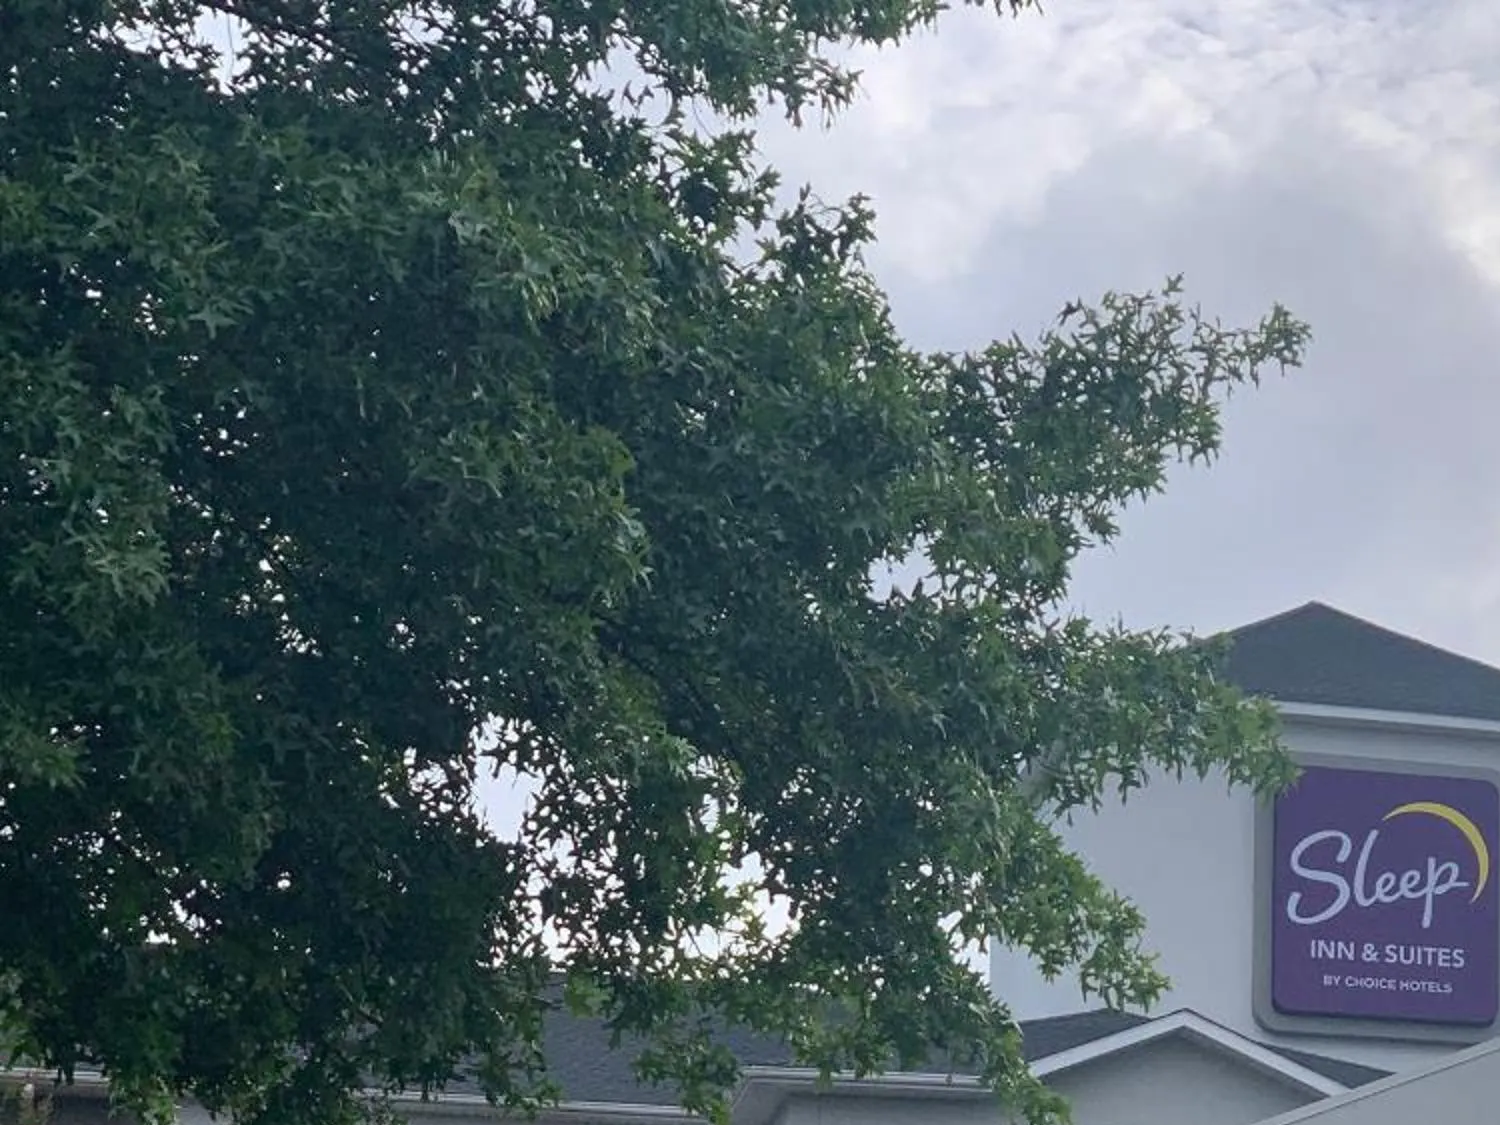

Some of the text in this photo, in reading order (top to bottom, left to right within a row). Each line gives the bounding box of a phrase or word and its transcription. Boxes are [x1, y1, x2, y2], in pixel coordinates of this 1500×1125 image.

[1287, 829, 1469, 928] Sleep
[1310, 939, 1465, 968] INN & SUITES
[1323, 974, 1453, 993] BY CHOICE HOTELS
